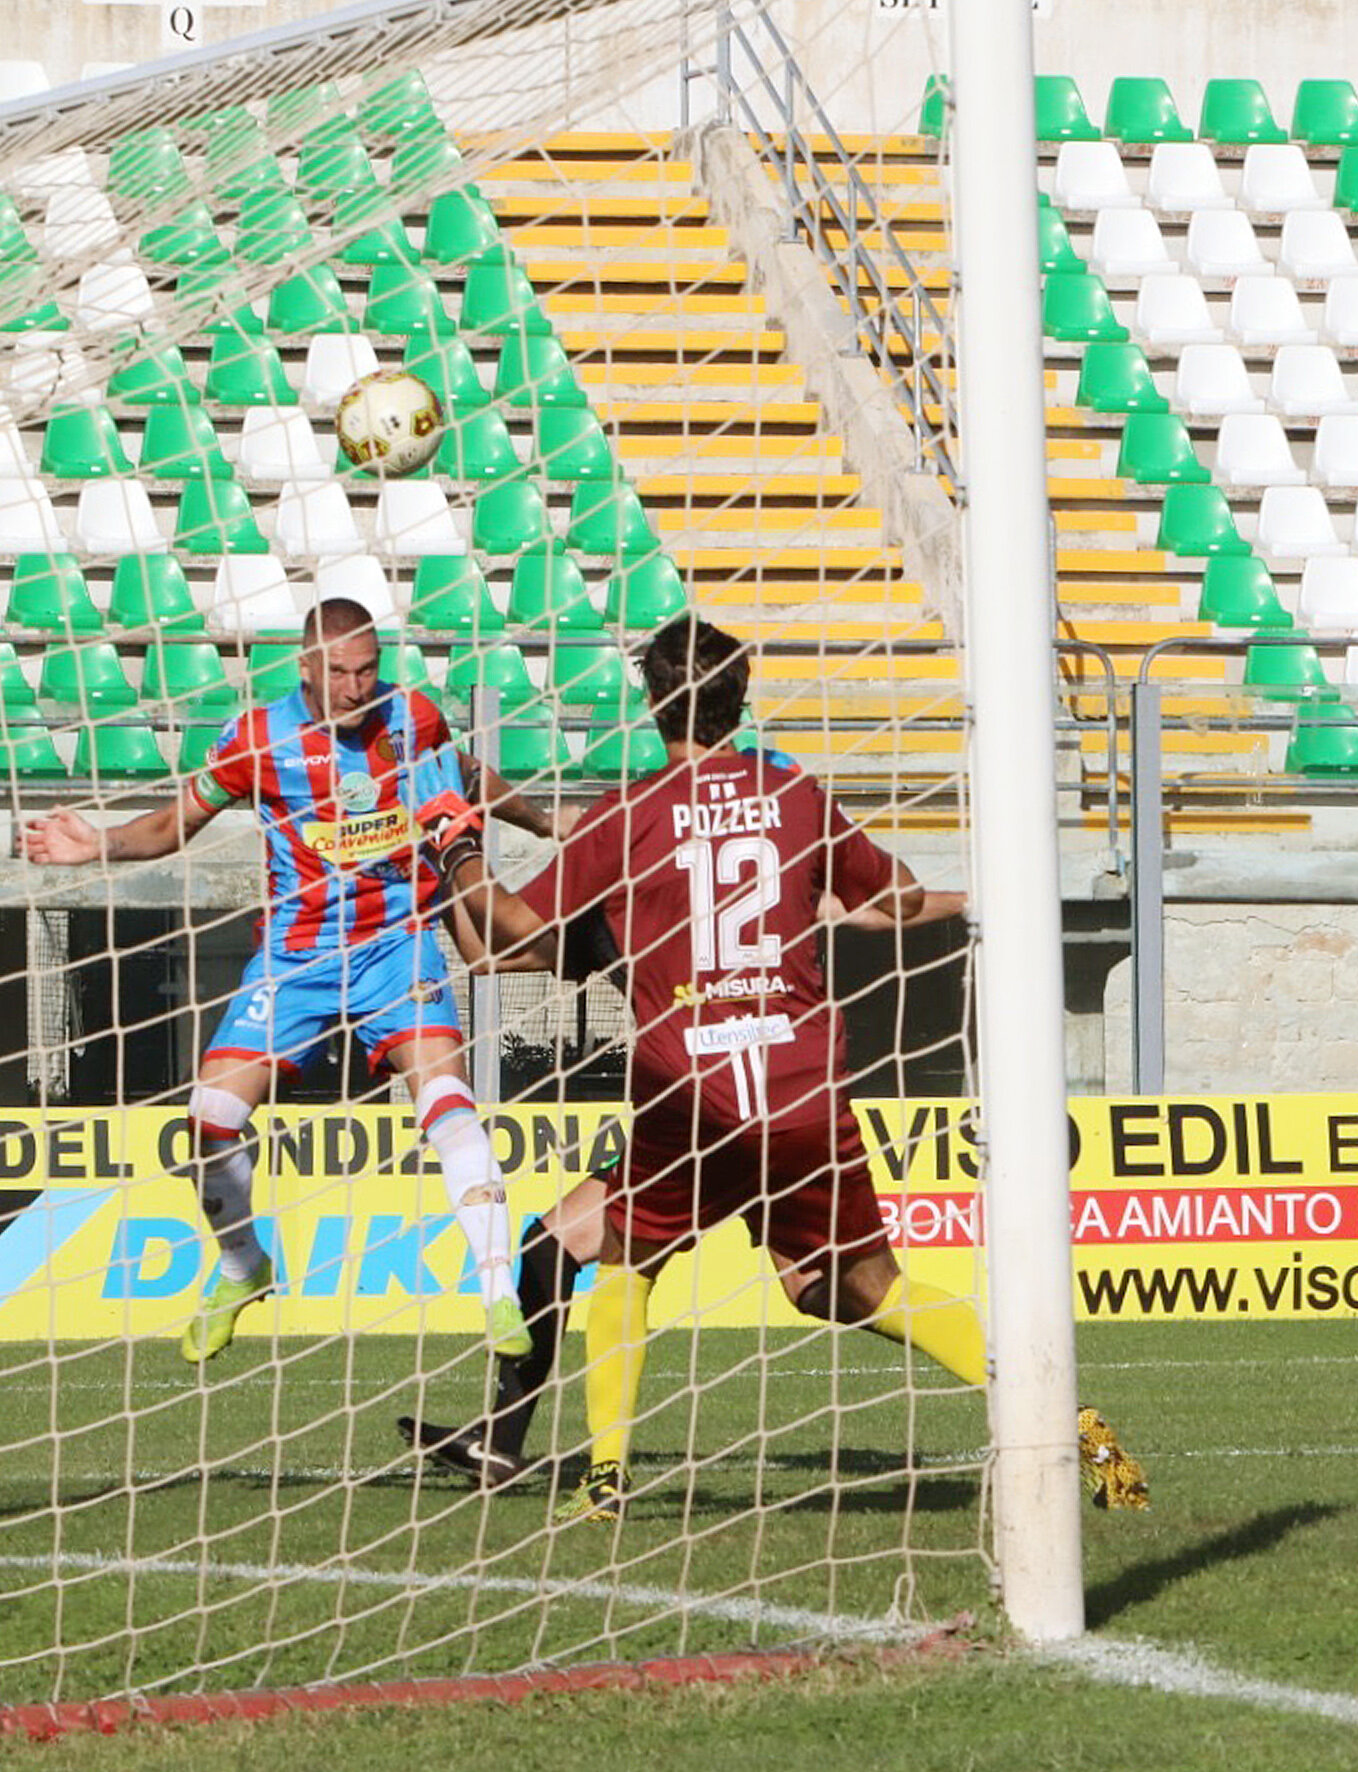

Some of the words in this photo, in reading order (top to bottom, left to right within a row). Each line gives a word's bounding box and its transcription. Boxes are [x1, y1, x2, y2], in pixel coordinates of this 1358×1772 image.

[170, 7, 195, 41] Q
[672, 797, 782, 839] POZZER
[675, 837, 782, 970] 12
[0, 1119, 134, 1178] DEL
[1110, 1102, 1303, 1177] EDIL
[1116, 1192, 1342, 1238] AMIANTO
